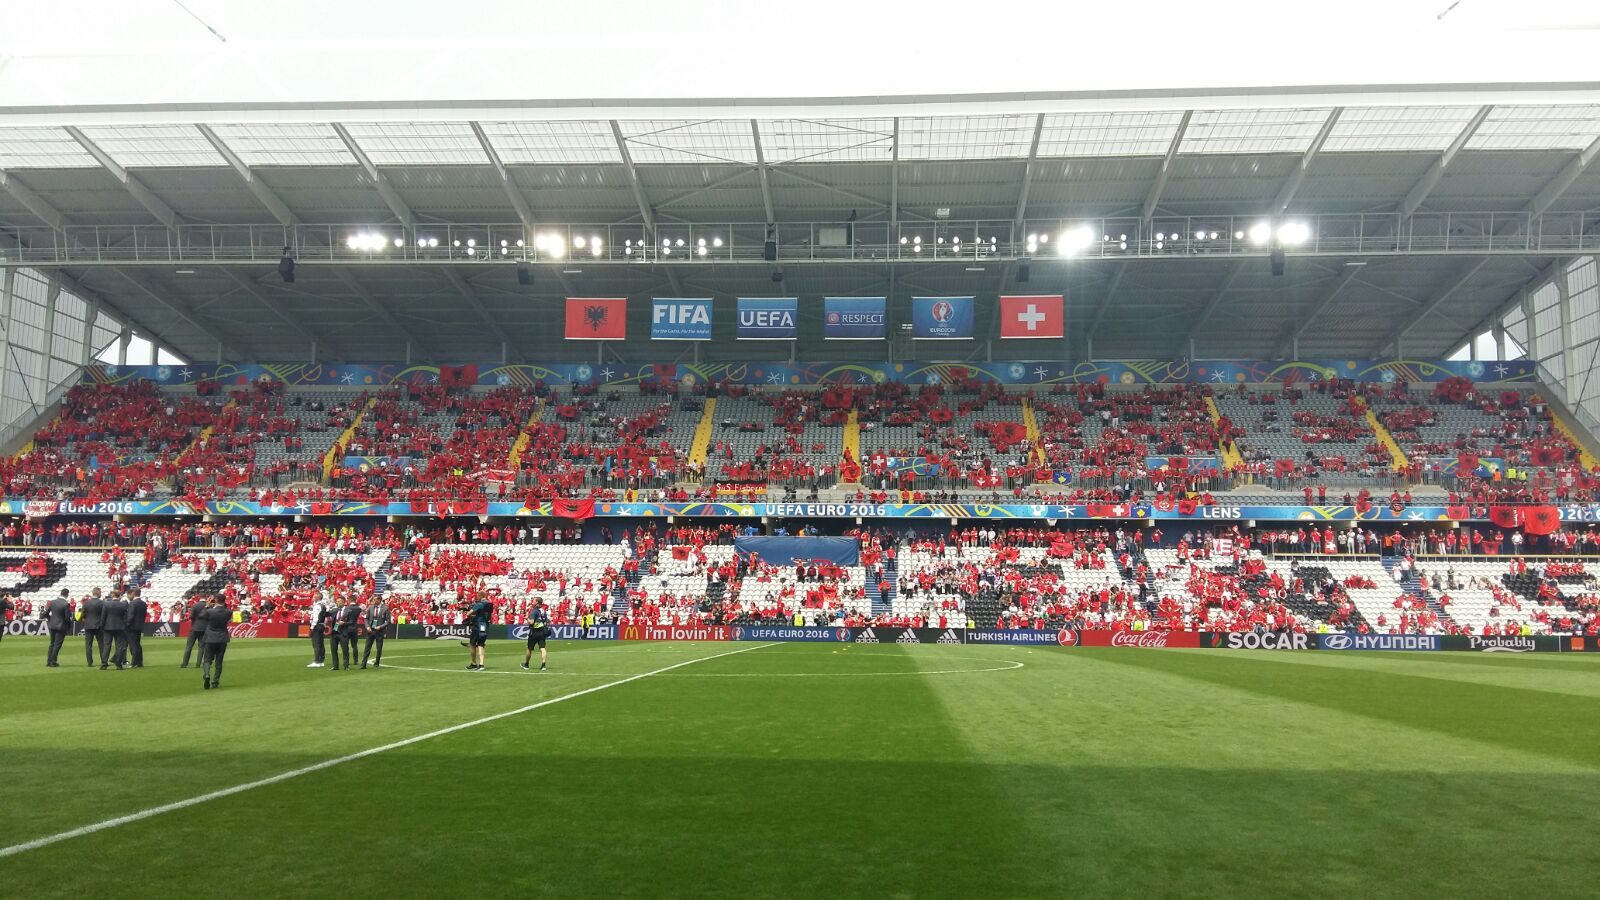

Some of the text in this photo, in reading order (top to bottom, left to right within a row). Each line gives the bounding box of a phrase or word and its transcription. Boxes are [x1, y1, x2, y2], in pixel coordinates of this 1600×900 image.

[653, 304, 710, 324] FIFA
[740, 311, 794, 327] UEFA
[842, 314, 884, 323] RESPECT
[98, 502, 133, 513] 2016
[766, 504, 886, 515] UEFA EURO 2016
[1202, 507, 1242, 518] LENS
[547, 626, 614, 639] YUNDAI
[645, 626, 667, 640] i'm
[671, 626, 712, 640] lovin'
[752, 630, 830, 639] UEFA EURO 2016
[968, 632, 1057, 642] TURKISH AIRLINES
[1227, 631, 1308, 650] SOCAR
[1355, 636, 1435, 650] HYUNDAI
[1467, 635, 1536, 651] Probably
